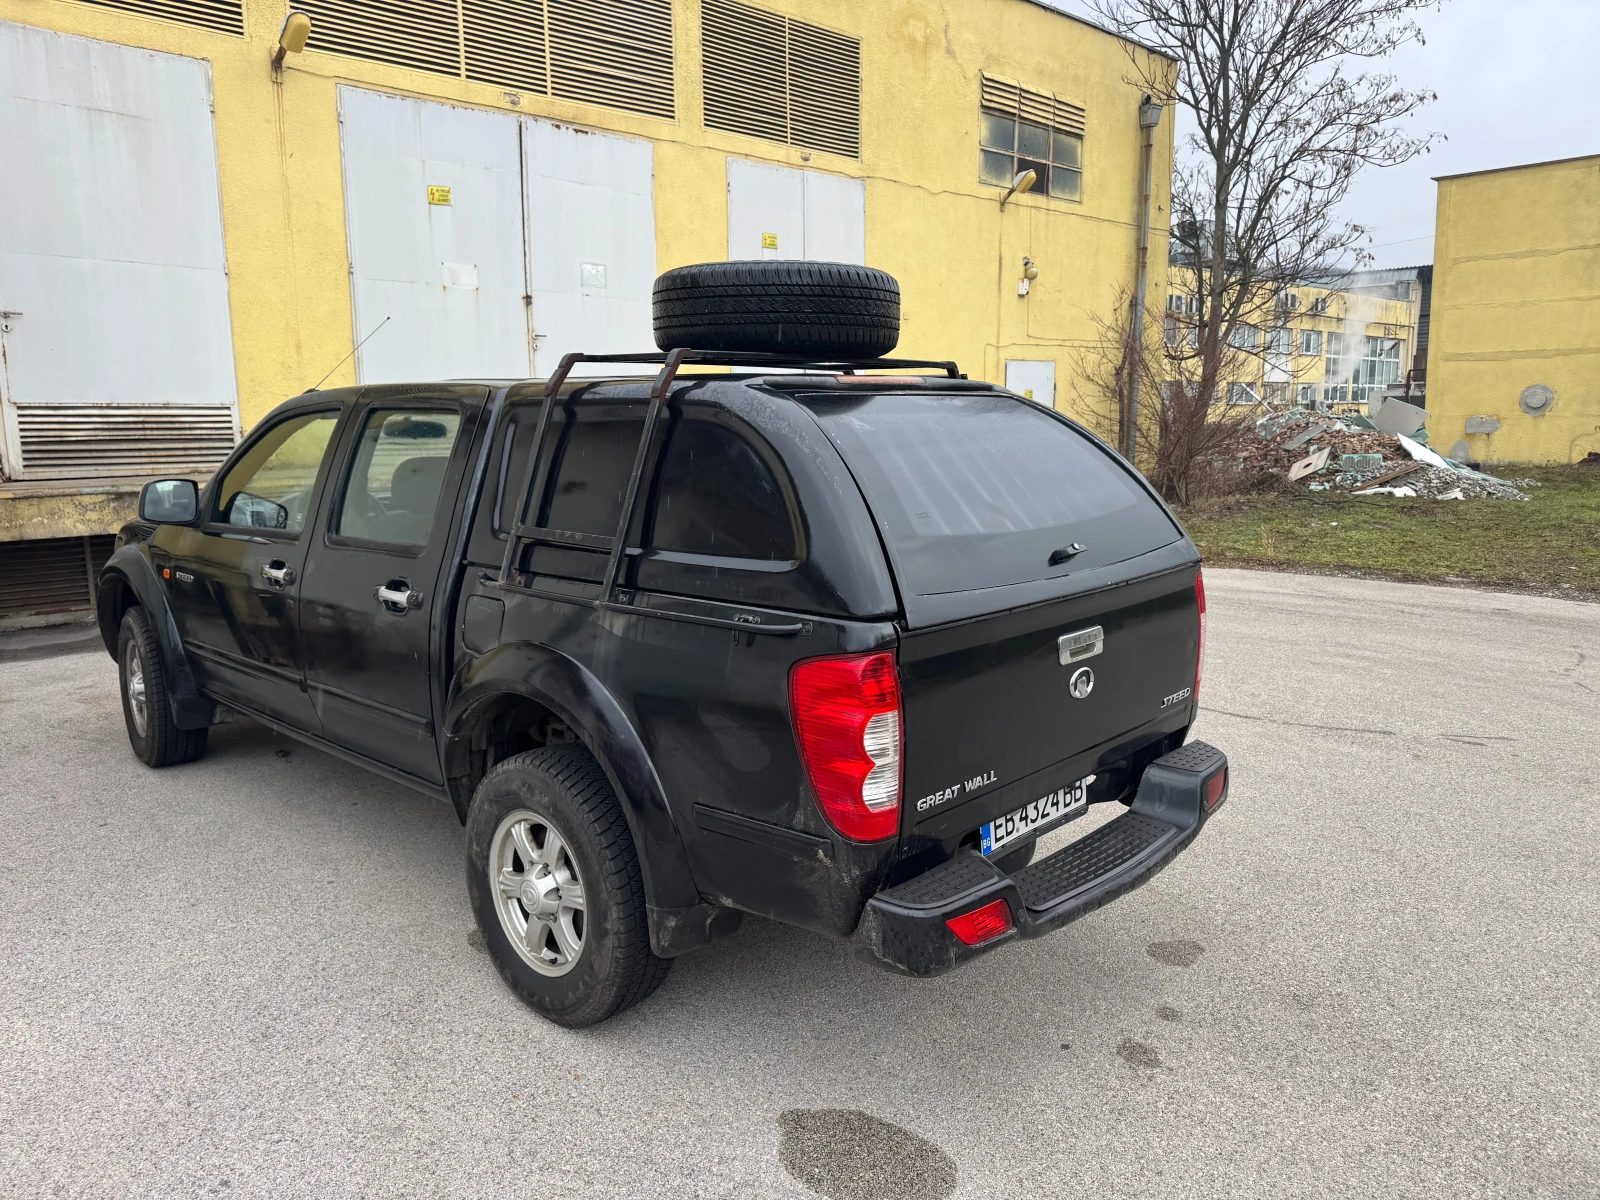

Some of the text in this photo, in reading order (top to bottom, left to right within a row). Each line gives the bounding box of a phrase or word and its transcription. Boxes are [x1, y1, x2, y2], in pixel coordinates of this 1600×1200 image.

[1160, 687, 1191, 708] STEED
[916, 770, 998, 812] GREAT WALL
[1019, 790, 1060, 828] 4324
[983, 837, 991, 849] BG
